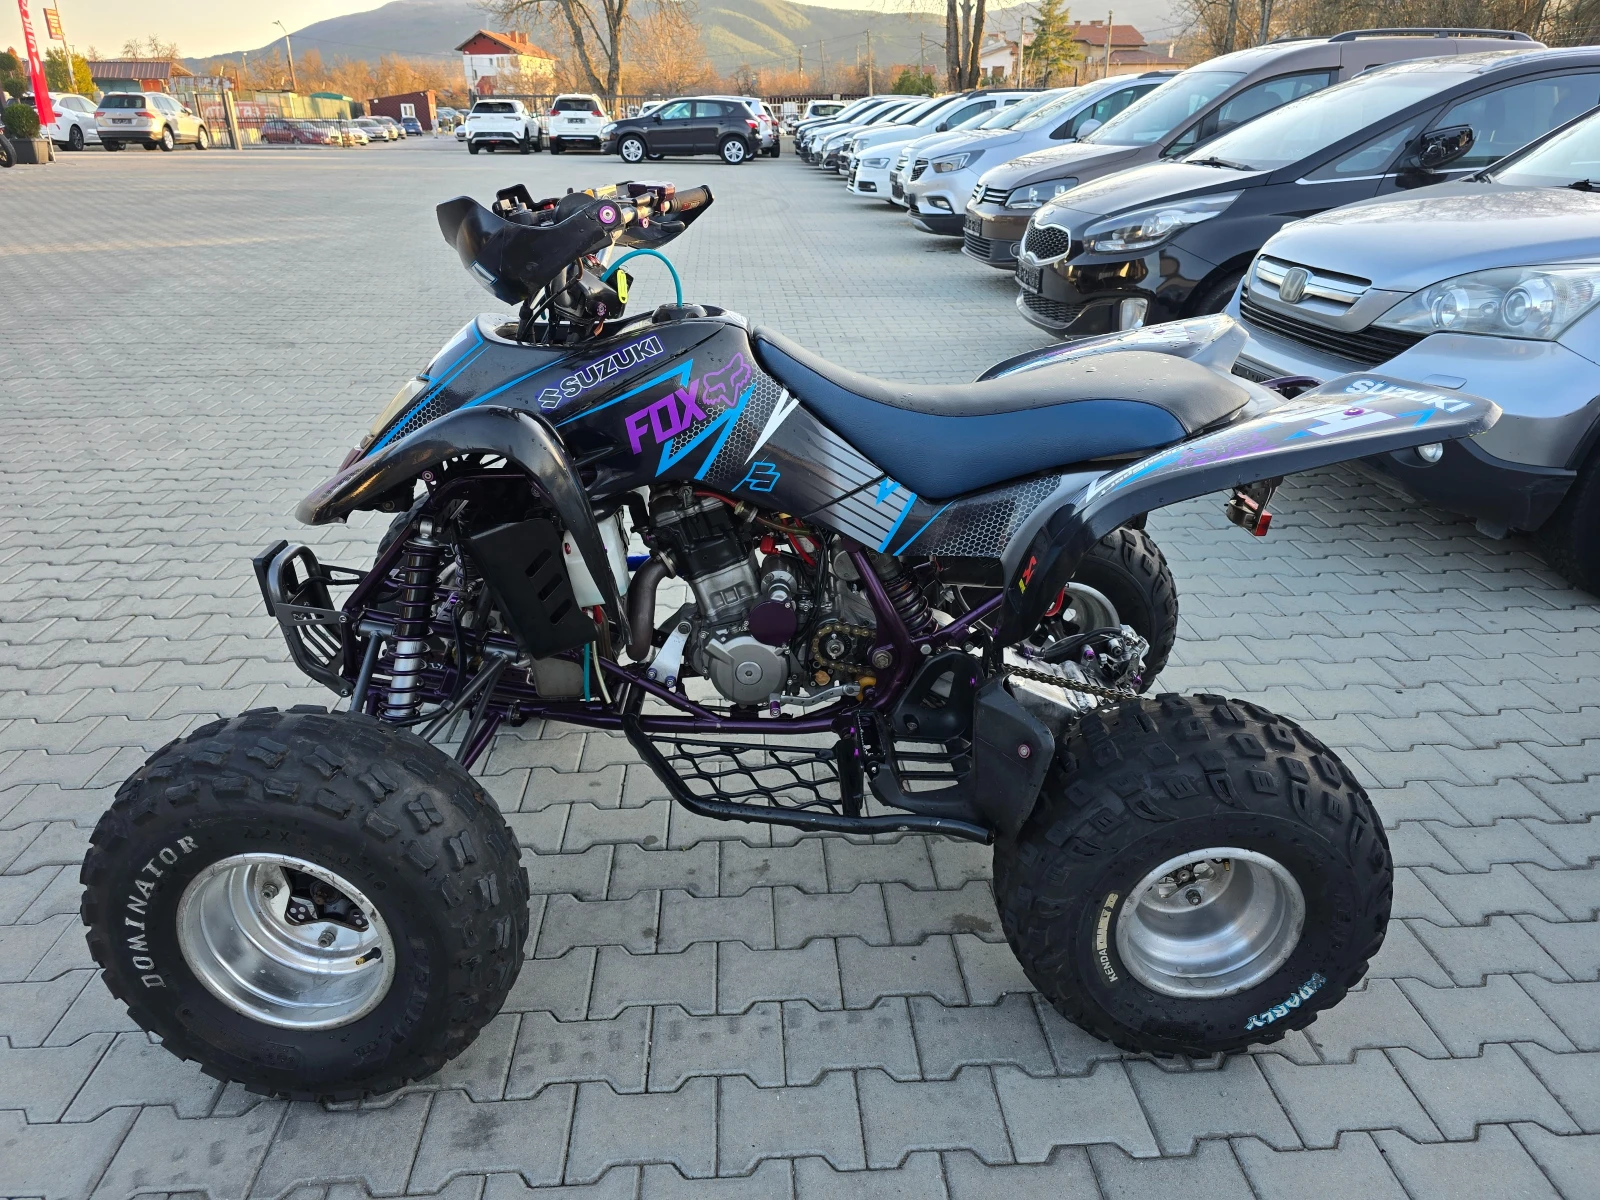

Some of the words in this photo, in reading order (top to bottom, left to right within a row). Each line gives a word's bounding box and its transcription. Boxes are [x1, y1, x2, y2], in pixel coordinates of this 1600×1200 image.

[560, 335, 664, 398] SUZUKI
[1344, 378, 1475, 414] SUZUKI
[624, 378, 708, 455] FOX
[124, 835, 199, 988] DOMINATOR
[1098, 950, 1118, 983] KENDA
